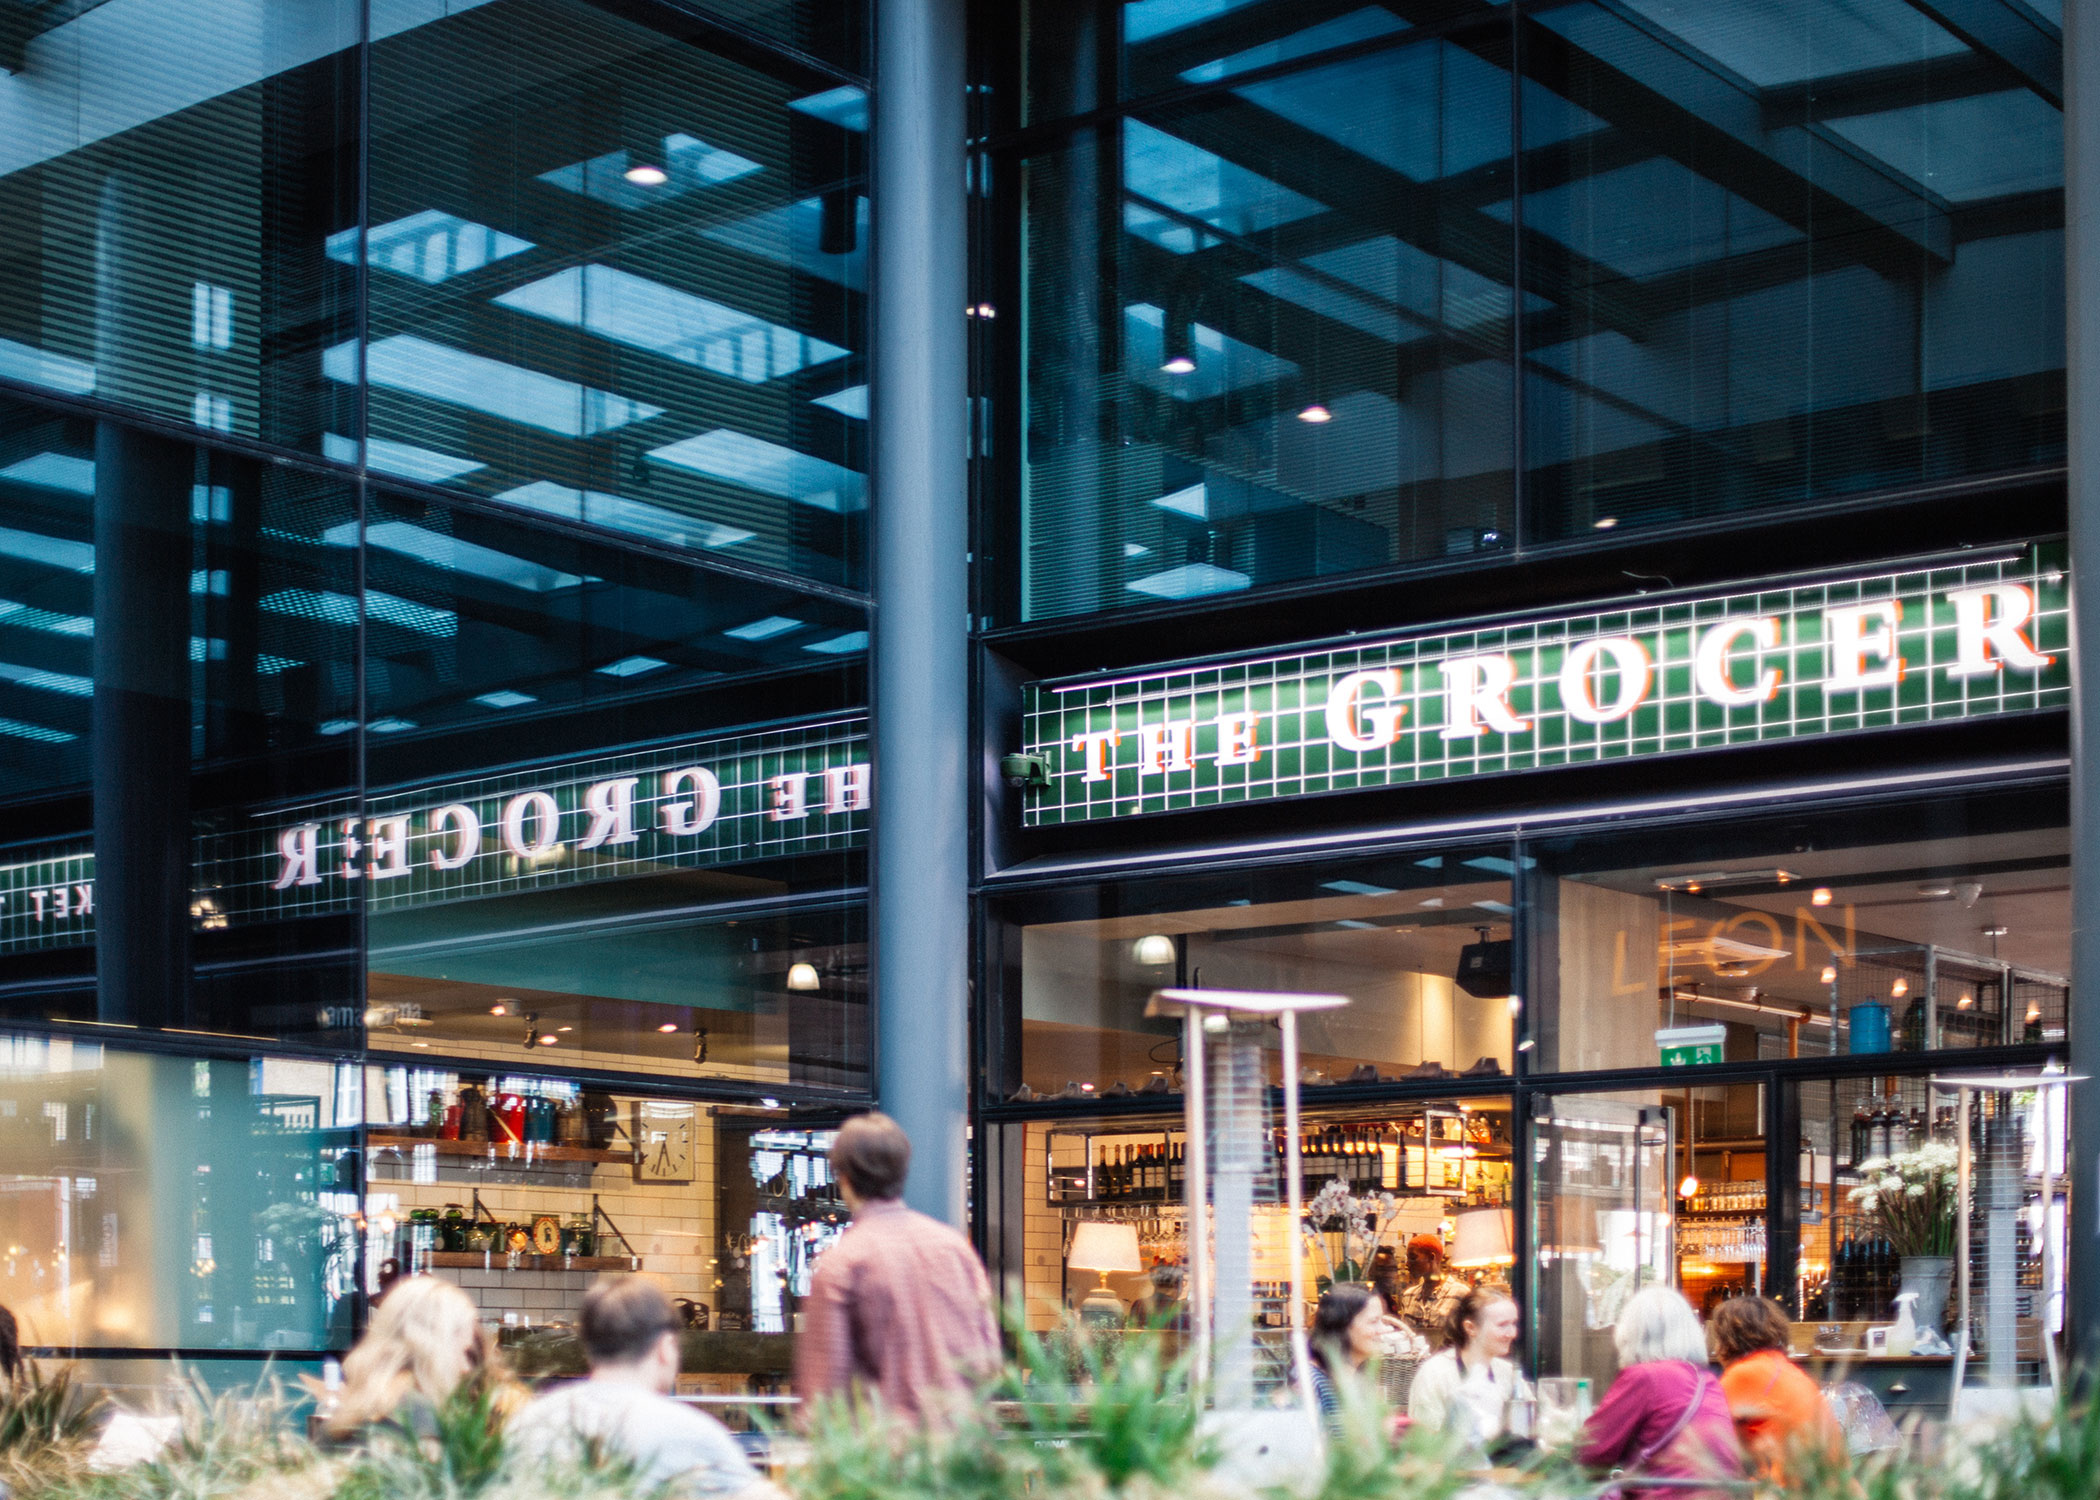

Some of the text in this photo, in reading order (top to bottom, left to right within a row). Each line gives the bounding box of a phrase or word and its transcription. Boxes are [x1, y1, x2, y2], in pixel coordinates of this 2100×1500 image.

[1072, 581, 2054, 783] THE GROCER
[1611, 904, 1856, 996] LEON
